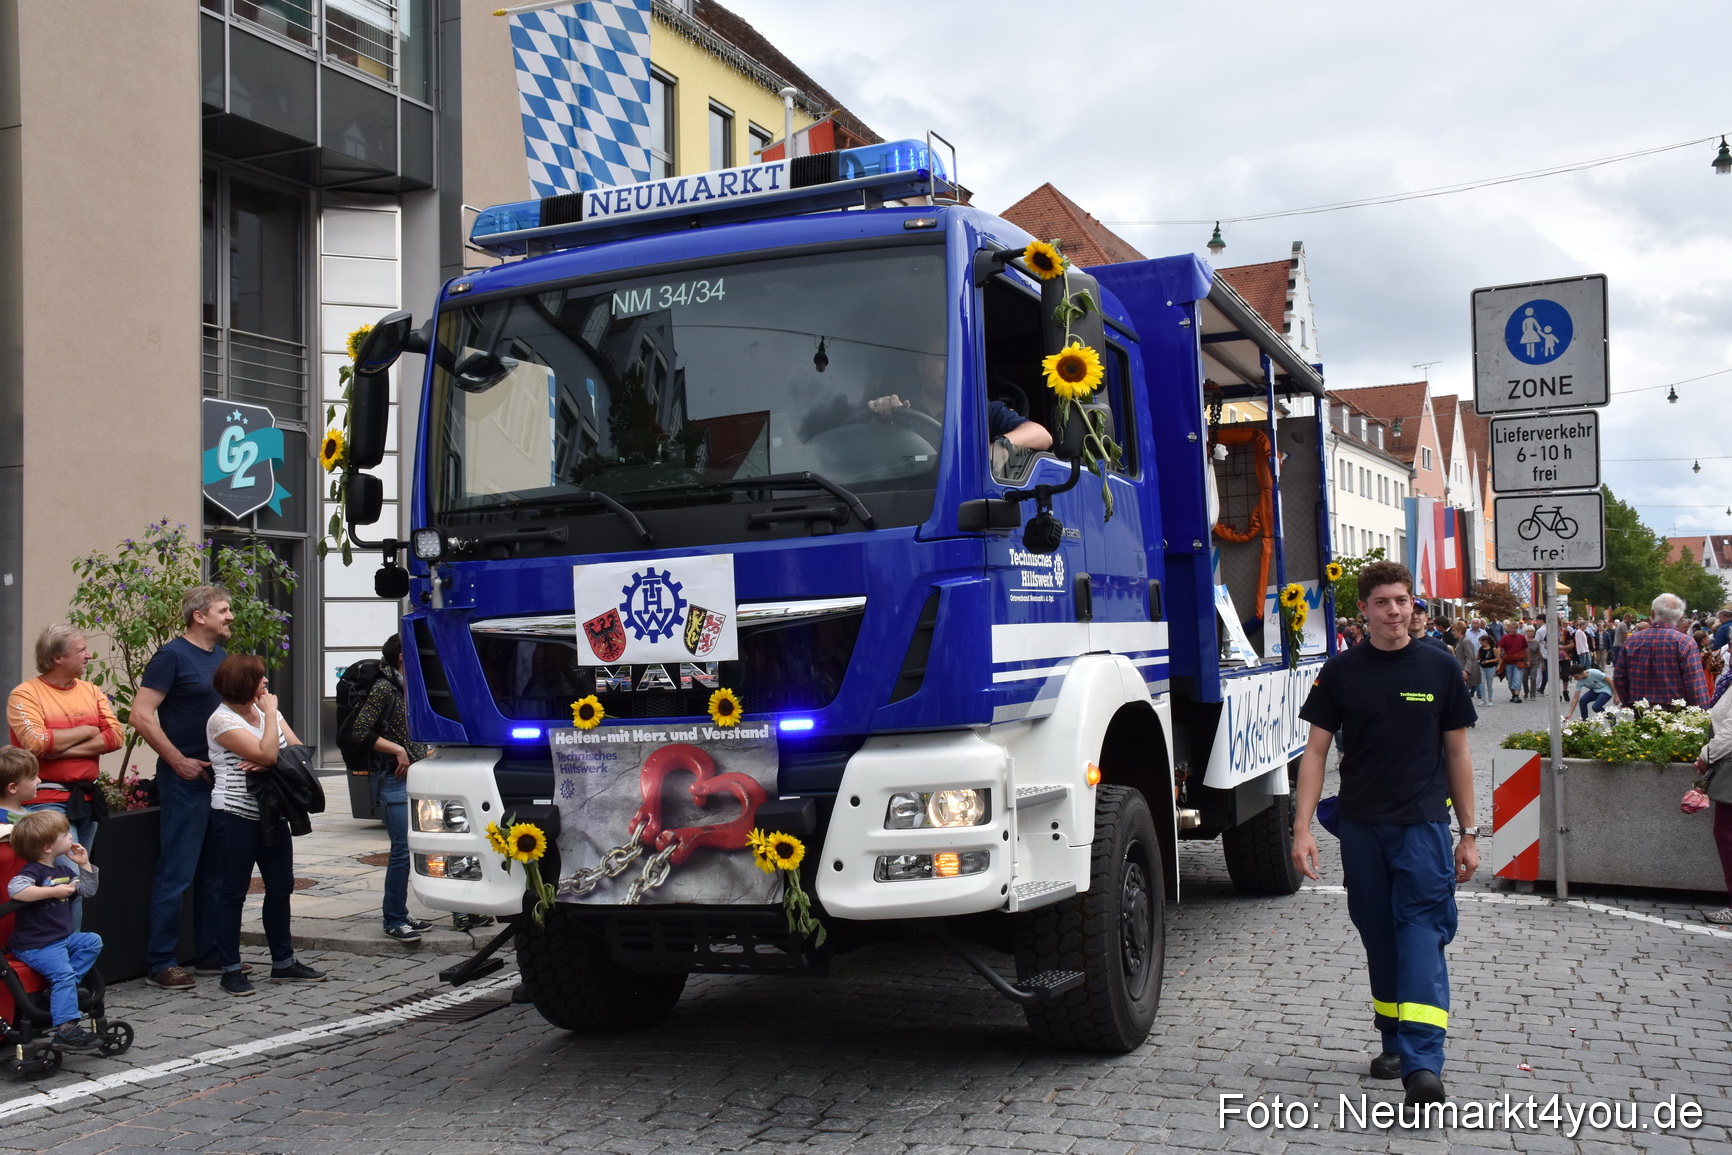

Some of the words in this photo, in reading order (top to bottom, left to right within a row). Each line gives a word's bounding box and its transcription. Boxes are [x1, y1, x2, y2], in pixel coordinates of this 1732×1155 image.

[588, 163, 786, 217] NEUMARKT
[611, 289, 651, 317] NM
[658, 277, 726, 308] 34/34
[1507, 375, 1574, 400] ZONE
[1495, 422, 1593, 444] Lieferverkehr
[217, 425, 259, 490] G2
[1563, 443, 1572, 460] h
[1532, 465, 1558, 482] frei
[1009, 548, 1053, 568] Technisches
[1532, 545, 1565, 561] frei
[1021, 570, 1054, 588] Hilfswerk
[595, 662, 719, 692] MAN
[633, 729, 668, 743] Herz
[670, 727, 698, 741] und
[701, 725, 769, 741] Verstand
[556, 750, 618, 763] Technisches
[560, 763, 609, 775] Hilfswerk
